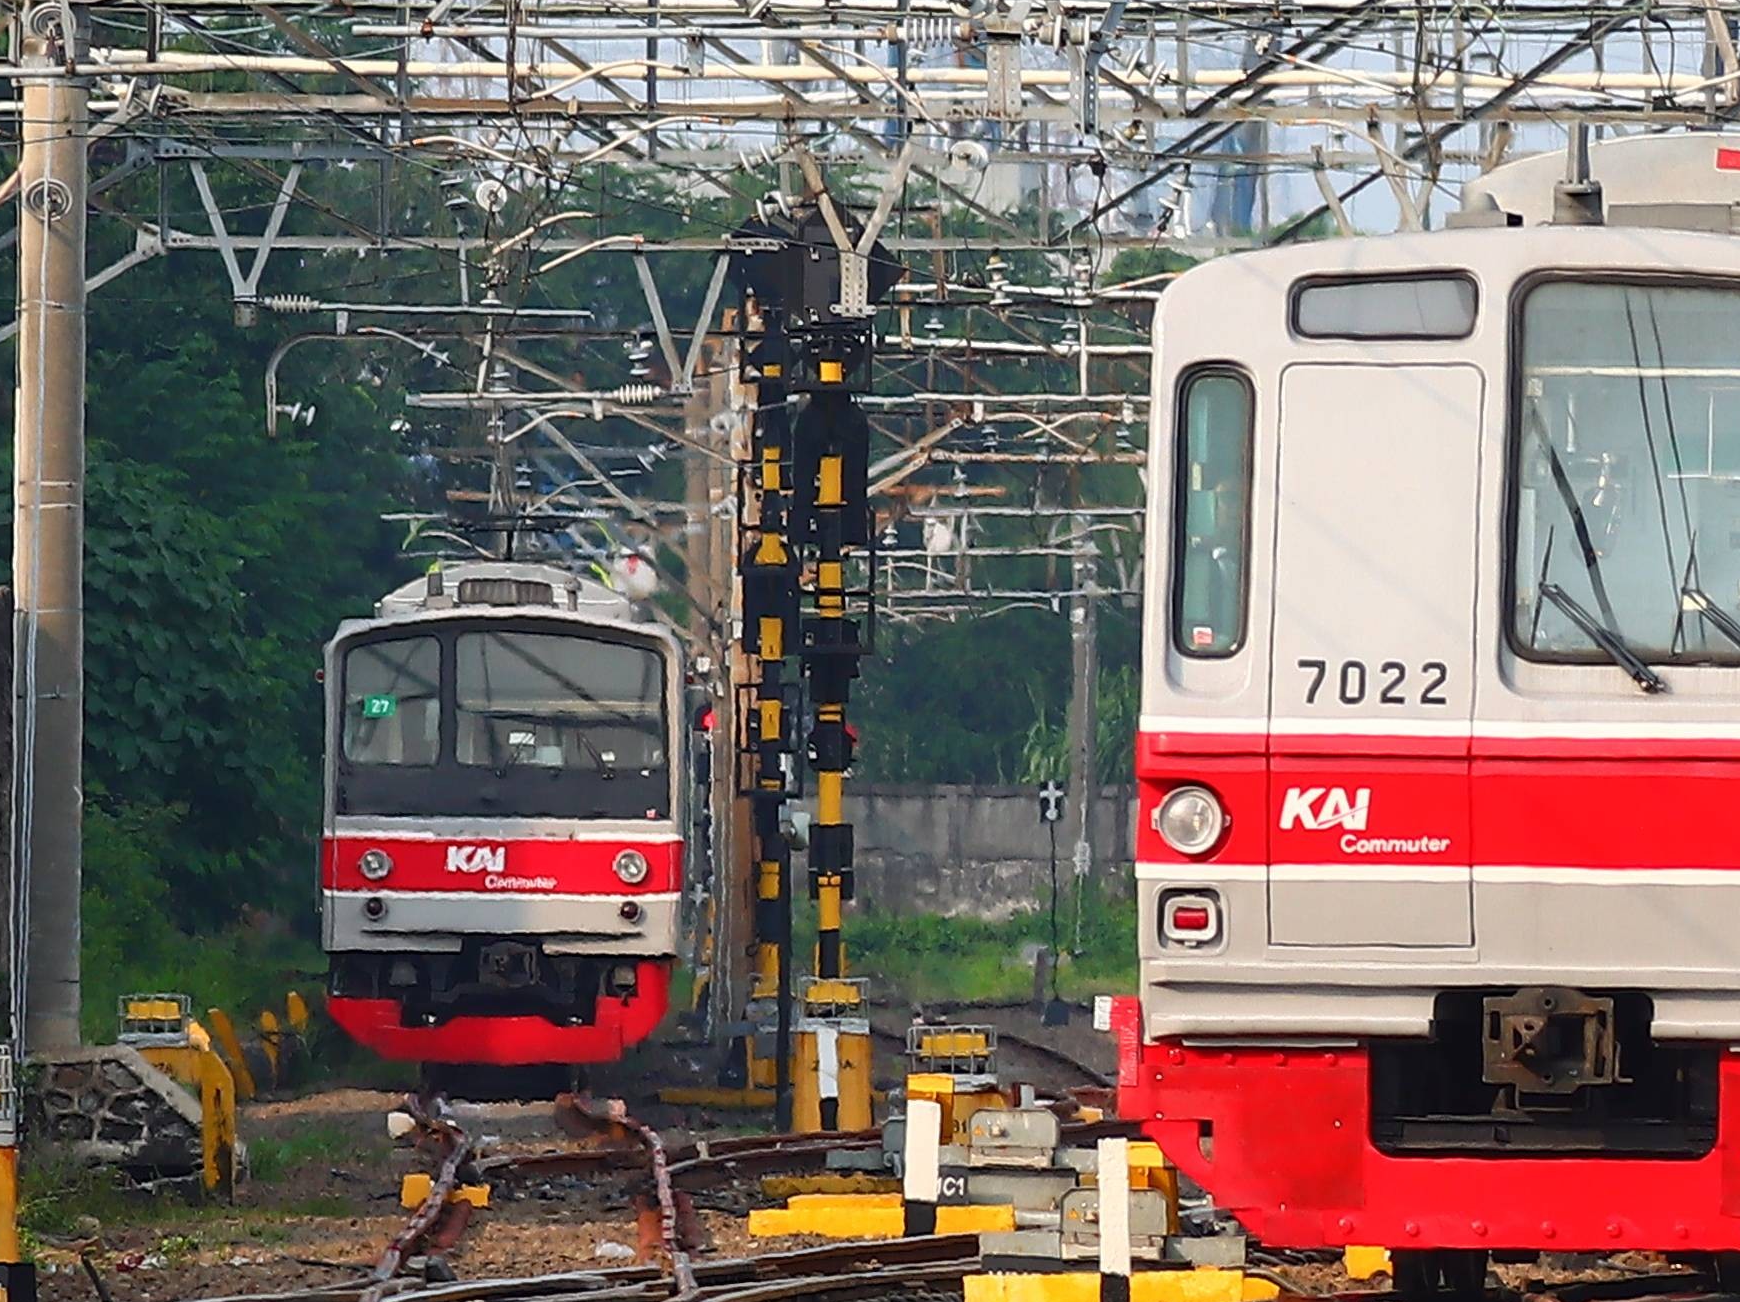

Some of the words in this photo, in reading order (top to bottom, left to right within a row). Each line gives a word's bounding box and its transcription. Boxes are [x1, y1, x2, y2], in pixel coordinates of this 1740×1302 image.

[1297, 659, 1448, 705] 7022
[1278, 786, 1372, 831] KAI
[446, 845, 506, 873] KAI
[1339, 834, 1451, 854] Commuter
